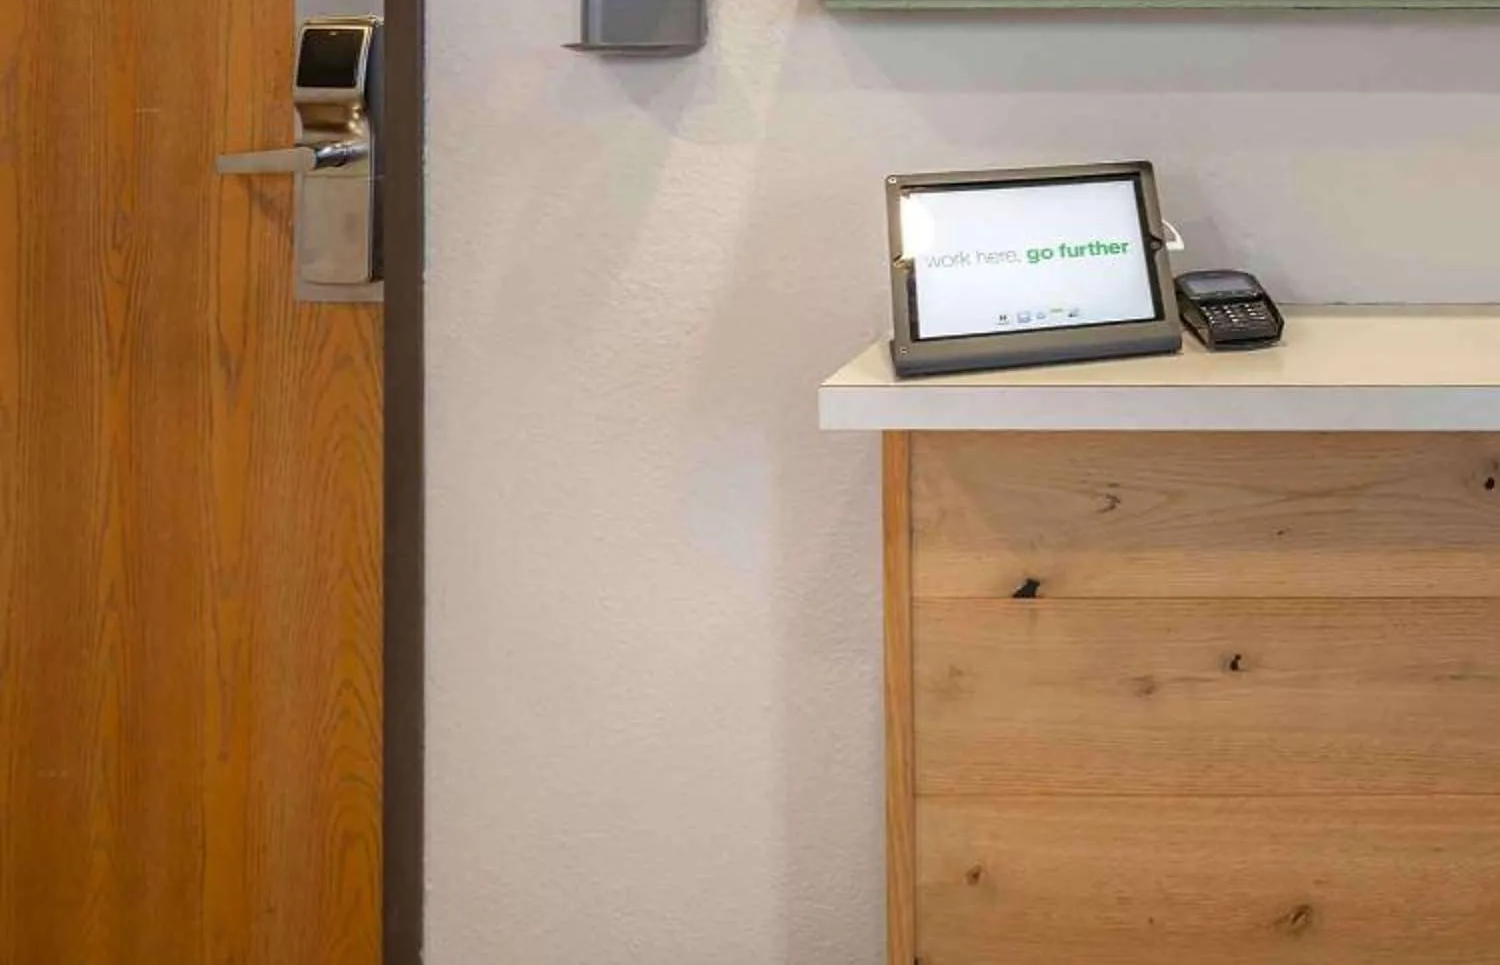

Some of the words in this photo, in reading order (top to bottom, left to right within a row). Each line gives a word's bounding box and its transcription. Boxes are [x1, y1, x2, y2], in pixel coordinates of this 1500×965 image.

[925, 250, 971, 268] work
[1026, 247, 1055, 265] go
[1058, 240, 1130, 259] further
